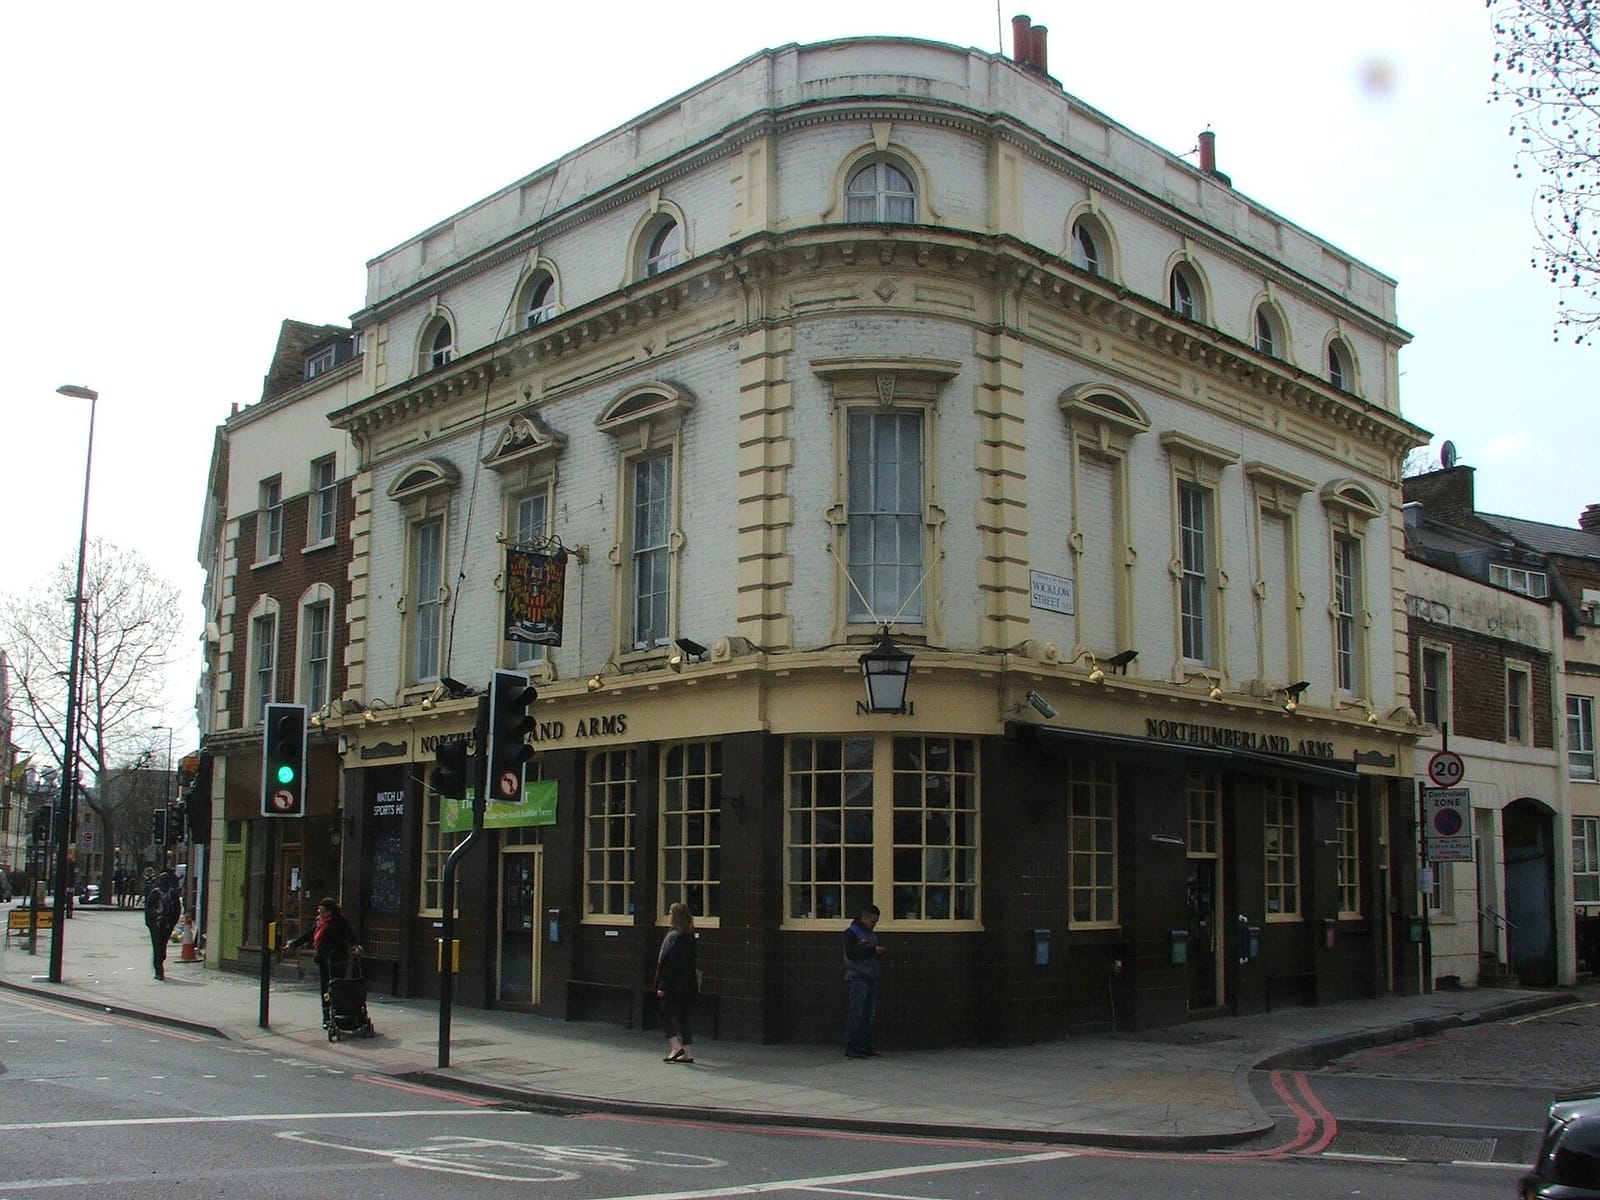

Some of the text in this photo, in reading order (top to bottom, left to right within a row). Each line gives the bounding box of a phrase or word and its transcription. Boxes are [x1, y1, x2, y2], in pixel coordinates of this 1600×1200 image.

[1032, 580, 1071, 598] WICKLOW
[1032, 593, 1060, 608] STREET
[575, 713, 627, 738] ARMS
[1146, 718, 1335, 759] NORTHUMBERLAND ARMS
[1434, 761, 1460, 777] 20
[377, 792, 396, 802] WATCH
[1428, 790, 1467, 798] Controlled
[374, 804, 395, 815] SPORTS
[1433, 798, 1461, 807] ZONE
